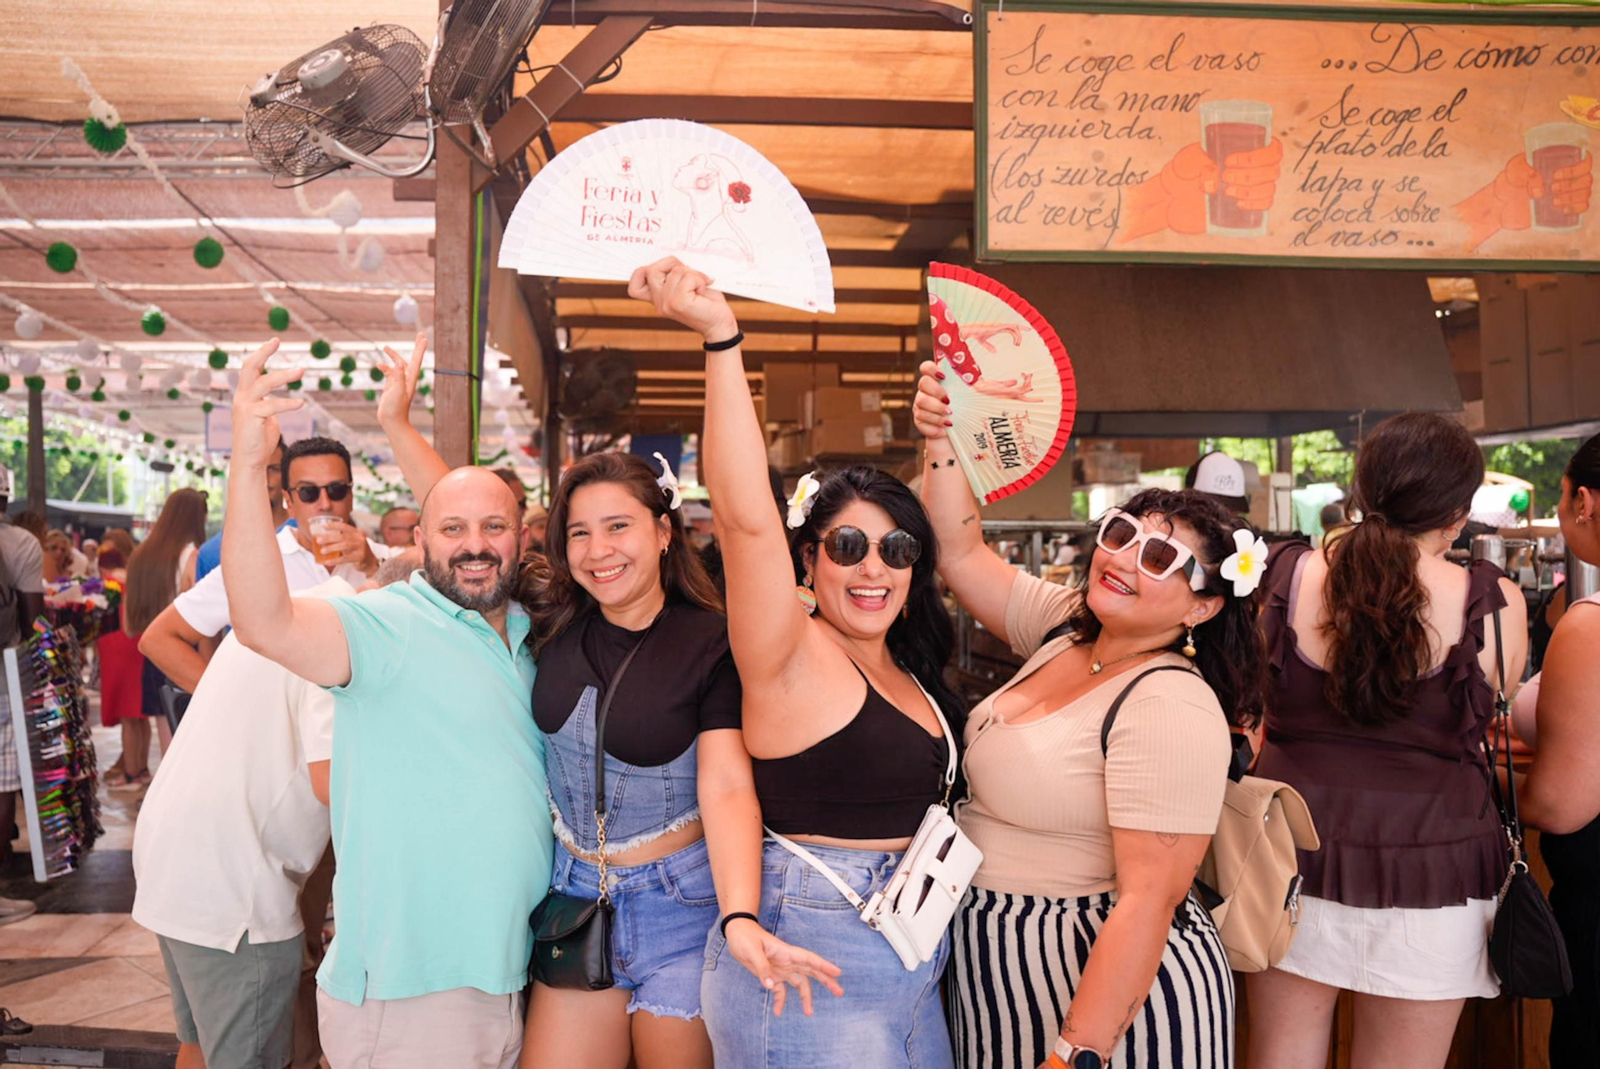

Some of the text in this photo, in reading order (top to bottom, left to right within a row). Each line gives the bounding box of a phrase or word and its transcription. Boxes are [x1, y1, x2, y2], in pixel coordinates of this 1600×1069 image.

[1000, 24, 1266, 91] Se coge el vaso
[1453, 42, 1549, 69] cómo
[998, 74, 1212, 112] con la mano
[1307, 84, 1467, 146] Se coge el
[996, 115, 1162, 156] izquierda.
[1293, 126, 1451, 173] plato de la
[1050, 157, 1150, 187] zurdos
[584, 178, 662, 211] Feria y
[991, 190, 1029, 225] al
[1290, 191, 1441, 223] coloca sobre
[1364, 178, 1385, 209] y
[1392, 175, 1420, 193] se
[581, 206, 661, 233] Fiestas
[1288, 220, 1323, 248] el
[973, 432, 988, 450] 2019
